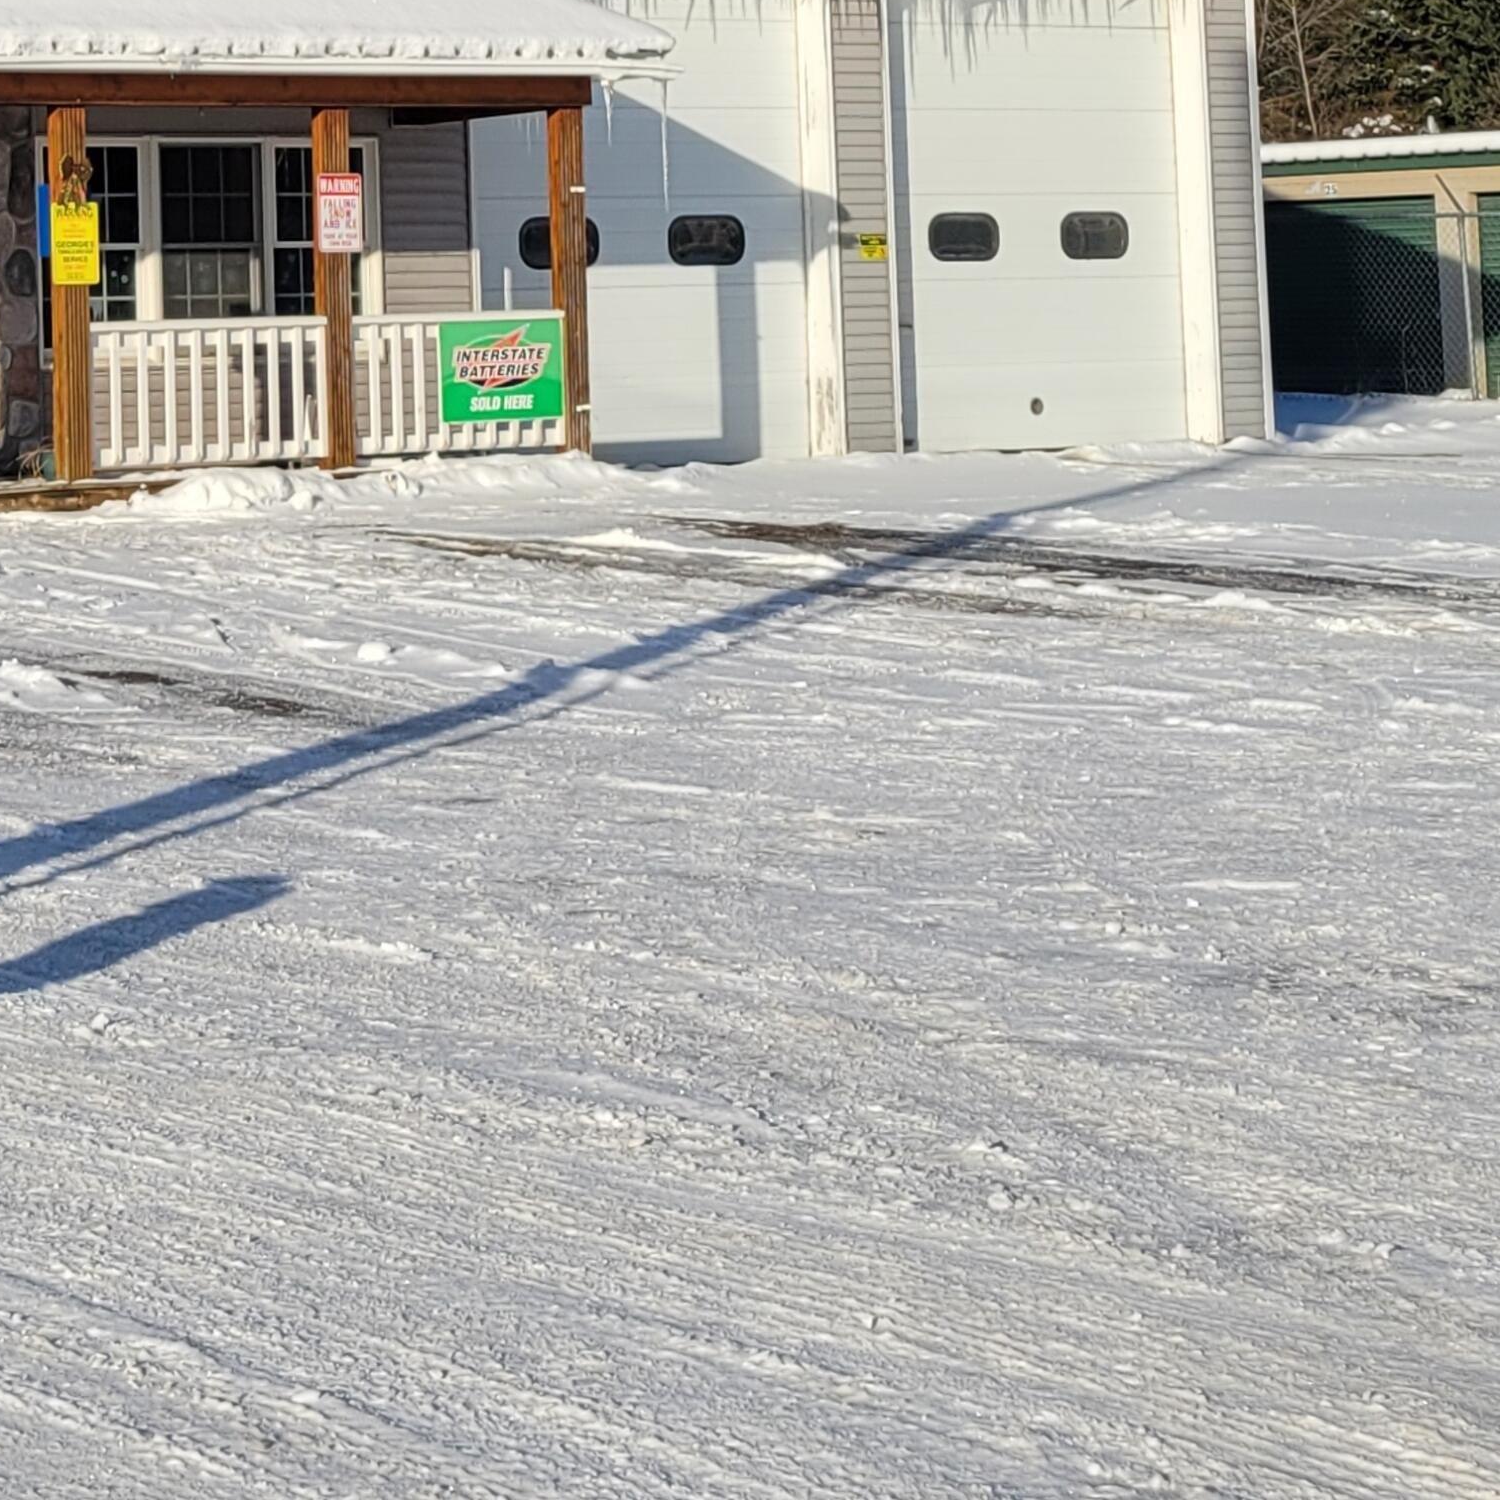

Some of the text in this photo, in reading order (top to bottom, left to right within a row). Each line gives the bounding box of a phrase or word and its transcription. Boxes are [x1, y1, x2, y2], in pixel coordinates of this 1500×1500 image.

[319, 177, 359, 194] WARNING
[323, 198, 357, 209] FALLING
[329, 208, 352, 219] SNOW
[323, 219, 341, 229] AND
[456, 347, 546, 362] INTERSTATE
[459, 363, 540, 378] BATTERIES
[470, 394, 535, 412] SOLD HERE
